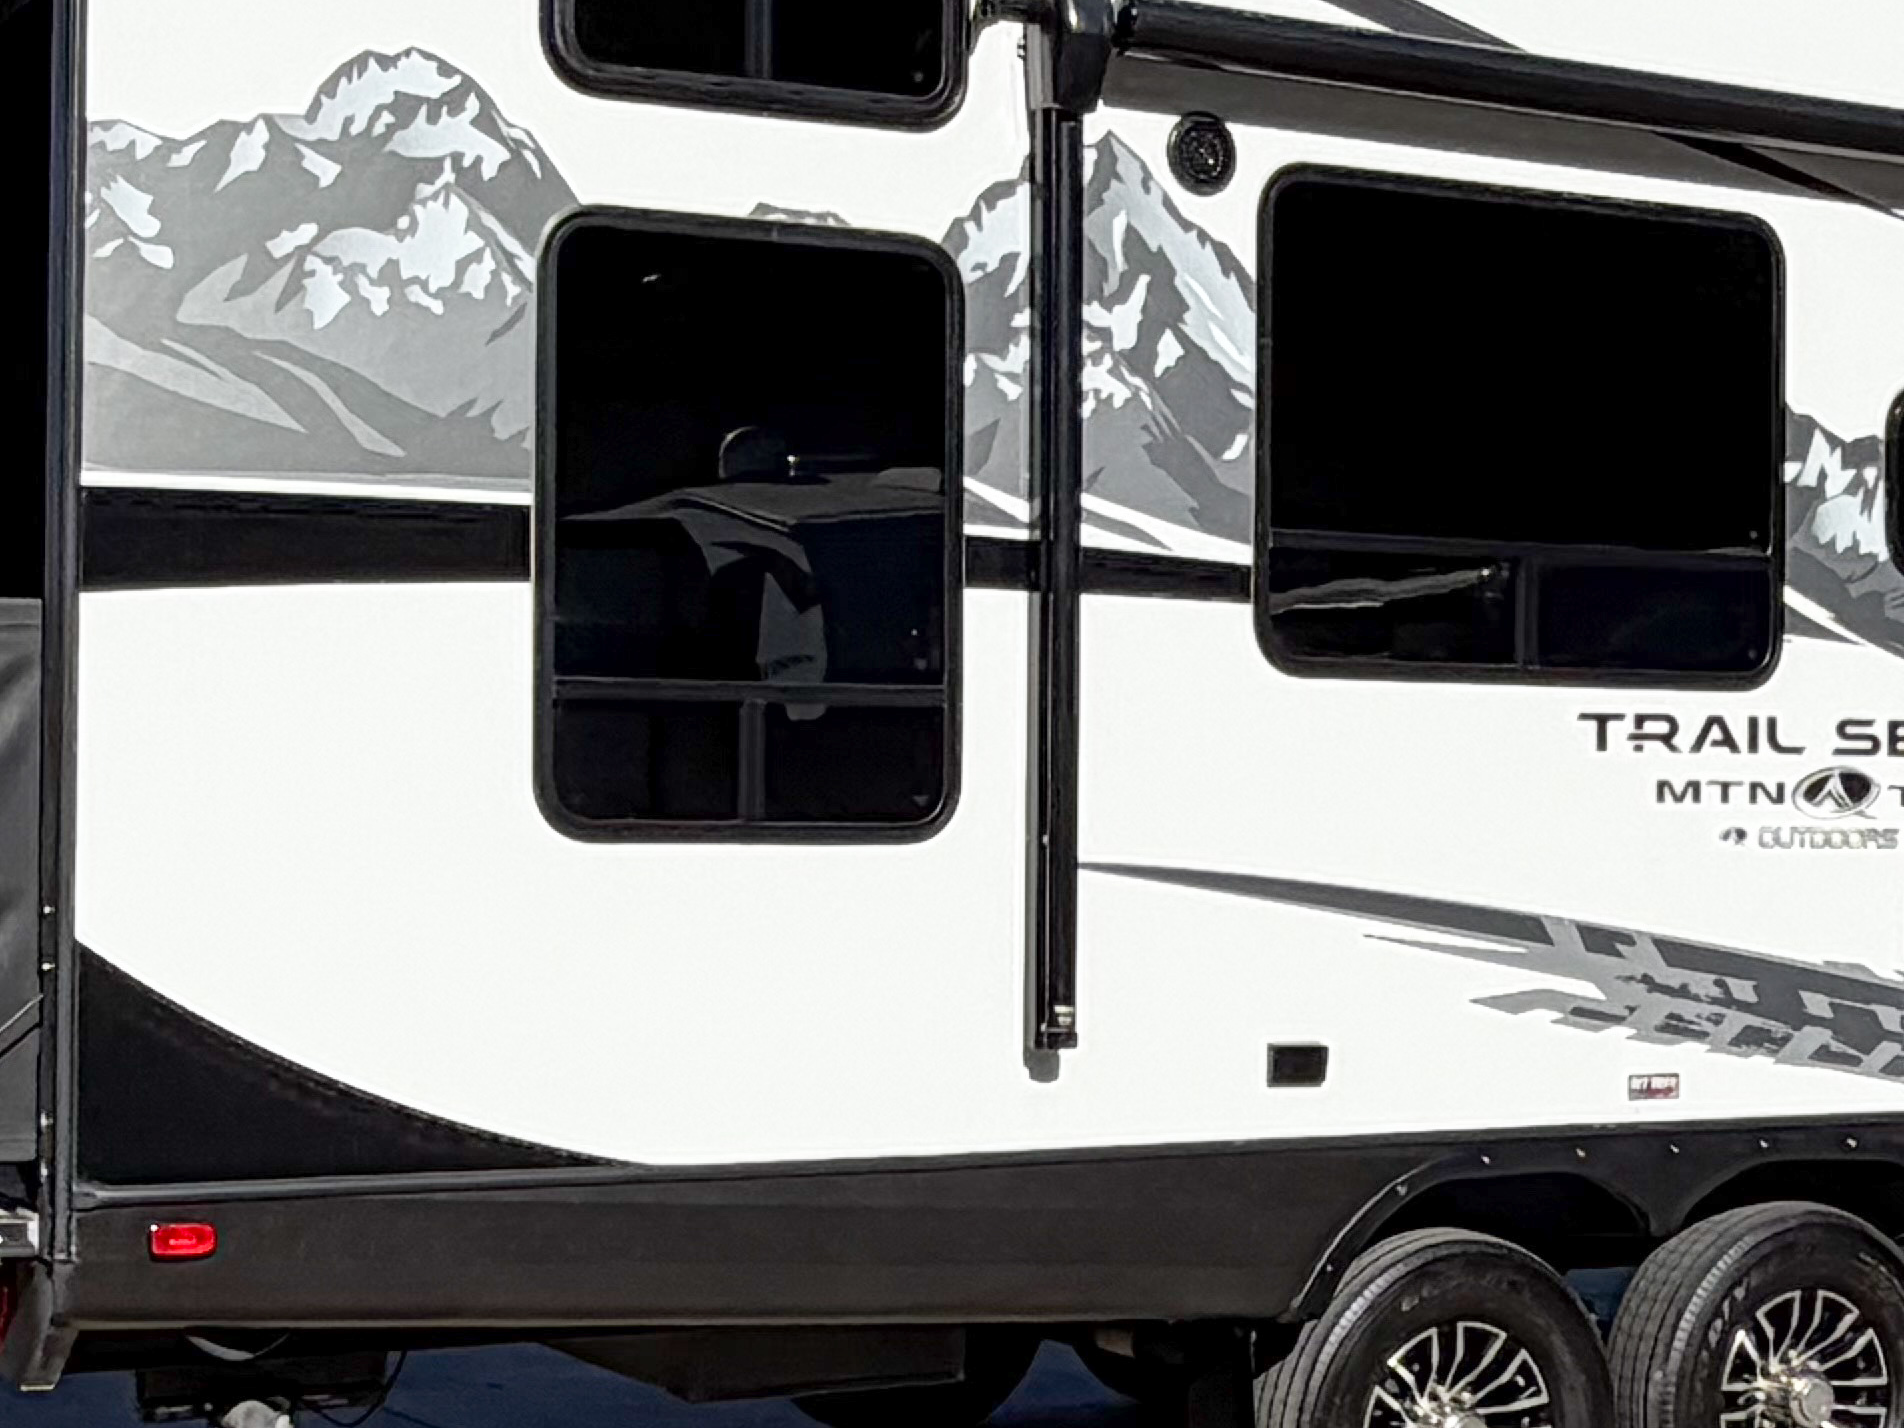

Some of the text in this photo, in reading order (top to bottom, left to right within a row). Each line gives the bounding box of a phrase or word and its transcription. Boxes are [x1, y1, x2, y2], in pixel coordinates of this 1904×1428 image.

[1577, 712, 1806, 755] TRAIL
[1656, 779, 1786, 806] MTN
[1758, 826, 1900, 850] OUTDOORS
